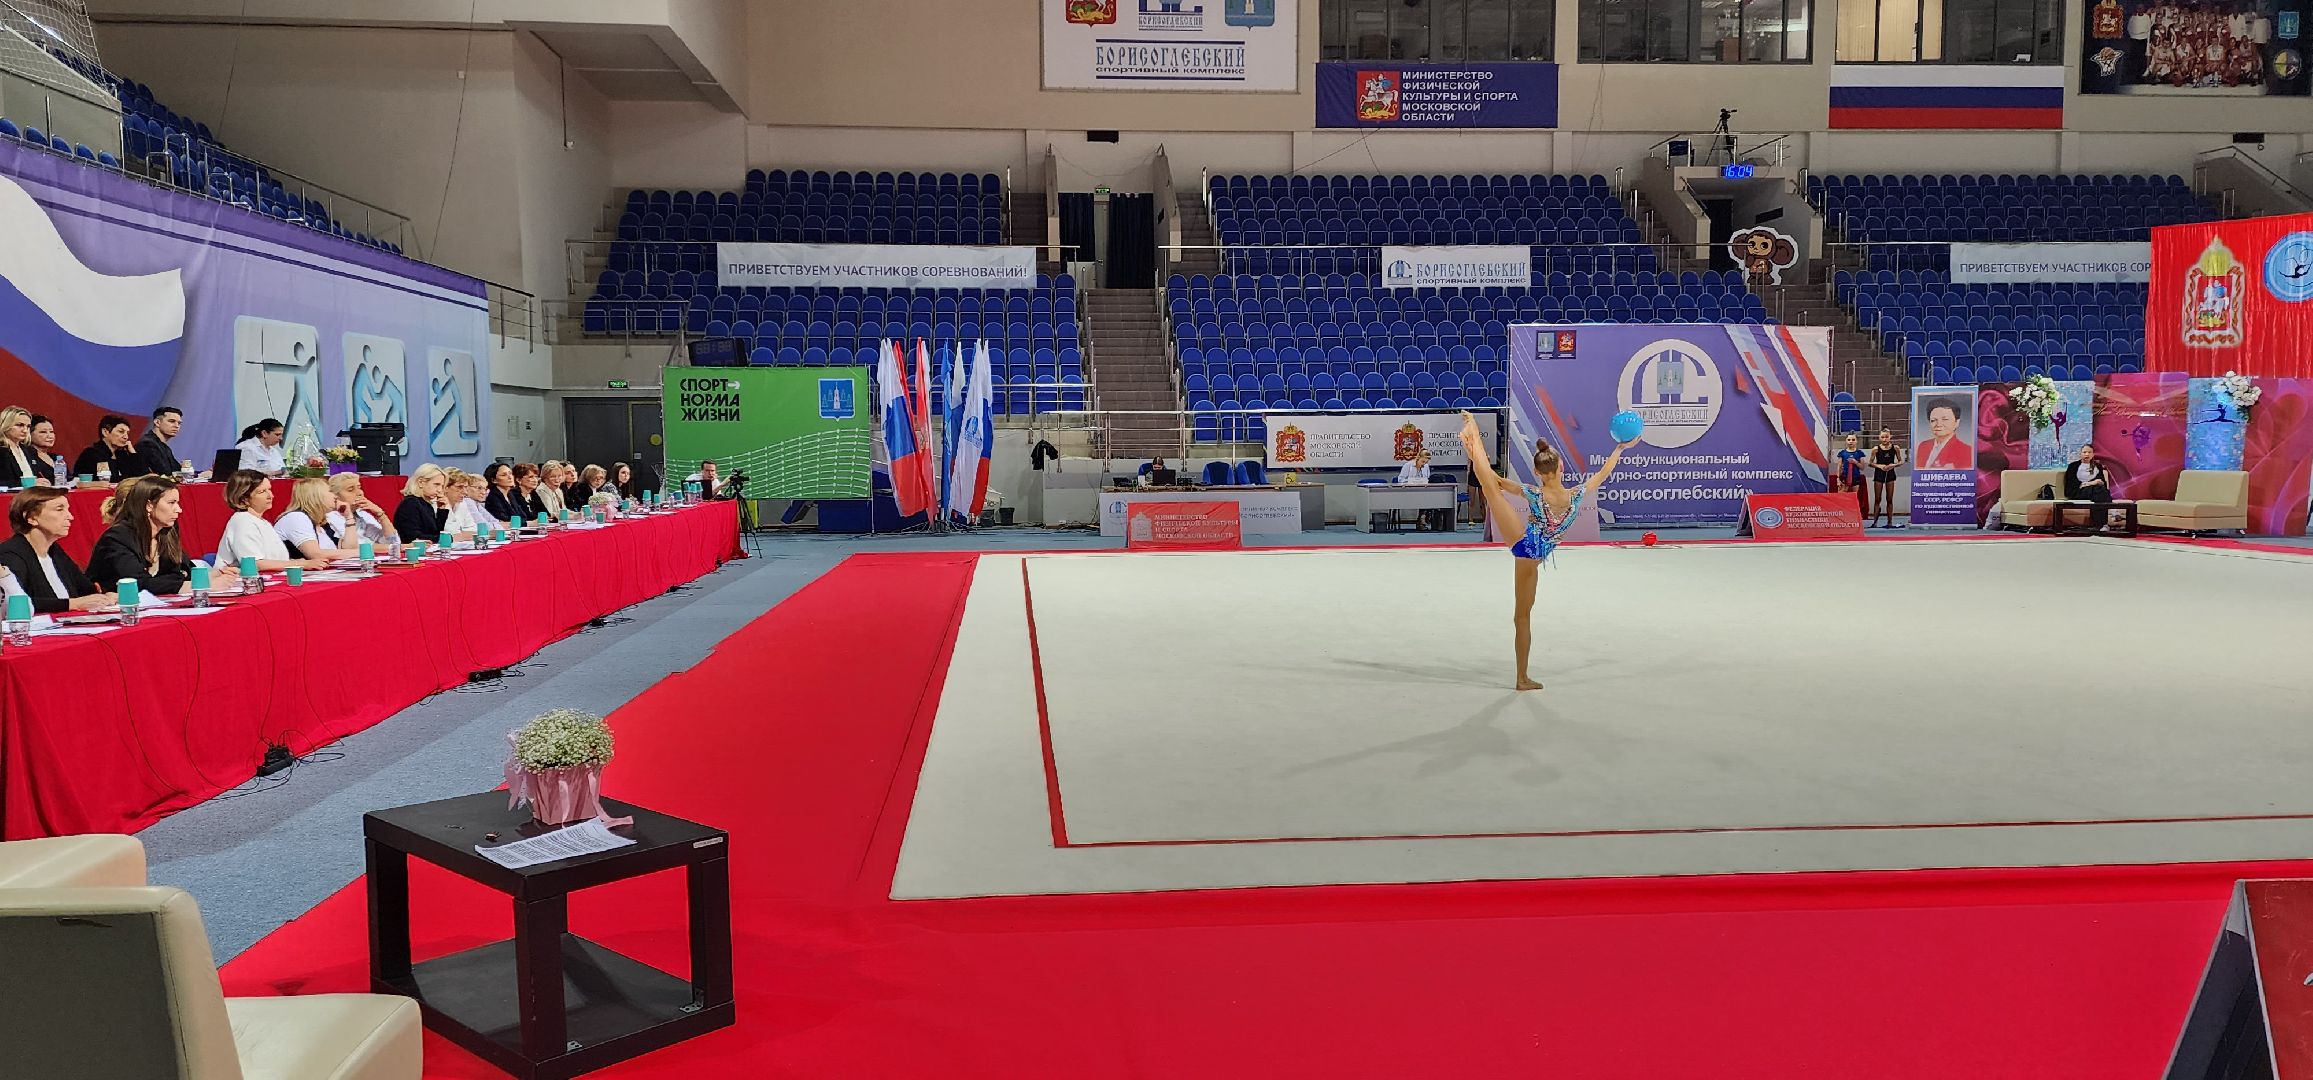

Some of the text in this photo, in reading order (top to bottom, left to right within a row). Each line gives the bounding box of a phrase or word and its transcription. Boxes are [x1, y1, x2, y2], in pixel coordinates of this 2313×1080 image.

[1095, 46, 1245, 68] БОРИСОГЛЕБСКИЙ
[1095, 66, 1179, 74] спортивный
[1402, 71, 1493, 80] МИНИСТЕРСТВО
[1402, 80, 1480, 90] ФИЗИЧЕСКОЙ
[1402, 92, 1518, 101] КУЛЬТУРЫ И СПОРТА
[1402, 101, 1481, 111] МОСКОВСКОЙ
[1402, 113, 1455, 121] ОБЛАСТИ
[728, 263, 1028, 278] ПРИВЕТСТВУЕМ УЧАСТНИКОВ СОРЕВНОВАНИЙ!
[1416, 262, 1526, 277] БОРИСОГЛЕБСКИЙ
[1959, 262, 2049, 273] ПРИВЕТСТВУЕМ
[2052, 262, 2127, 273] УЧАСТНИКОВ
[680, 378, 729, 391] СПОРТ
[680, 393, 740, 407] НОРМА
[681, 407, 740, 421] ЖИЗНИ
[1731, 471, 1793, 480] комплекс
[1920, 473, 1967, 481] ШИБАЕВА
